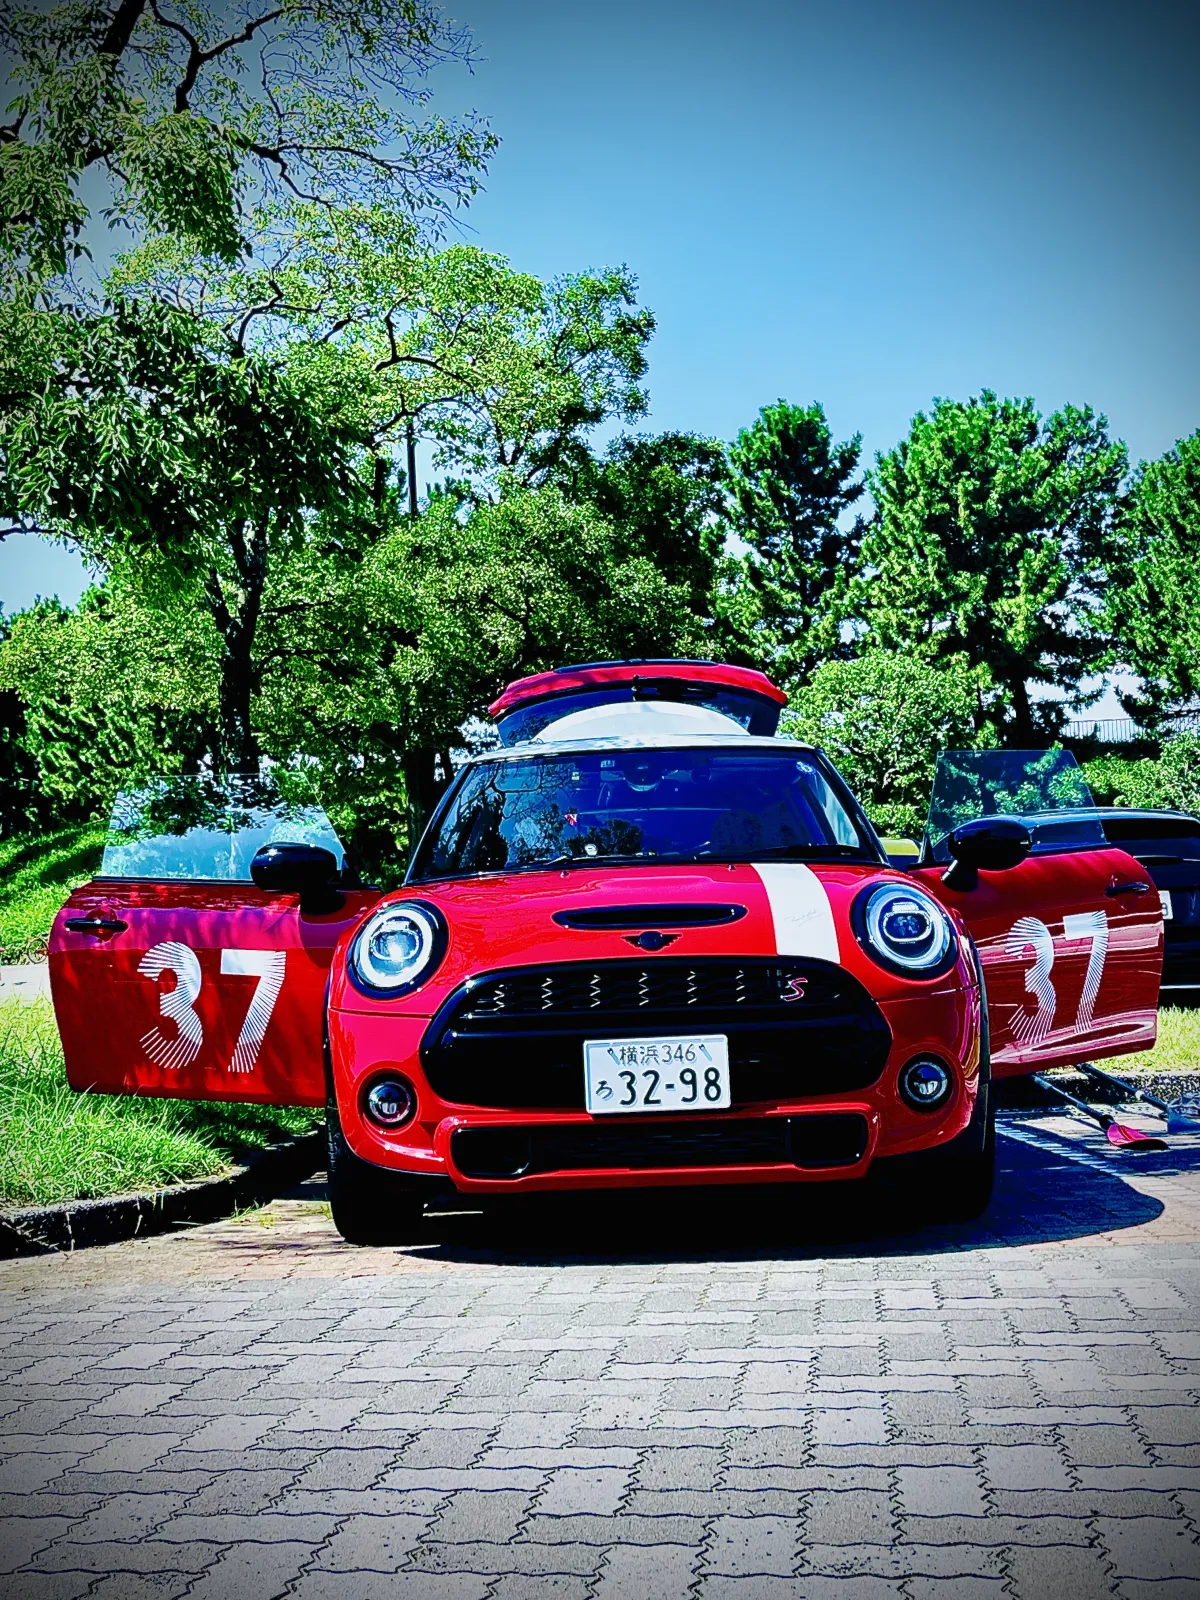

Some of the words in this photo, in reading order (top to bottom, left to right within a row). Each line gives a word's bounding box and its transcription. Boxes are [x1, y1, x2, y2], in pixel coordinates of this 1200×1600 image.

[137, 941, 286, 1073] 37
[780, 977, 808, 1002] S
[1004, 910, 1109, 1045] 37
[618, 1067, 721, 1106] 32-98
